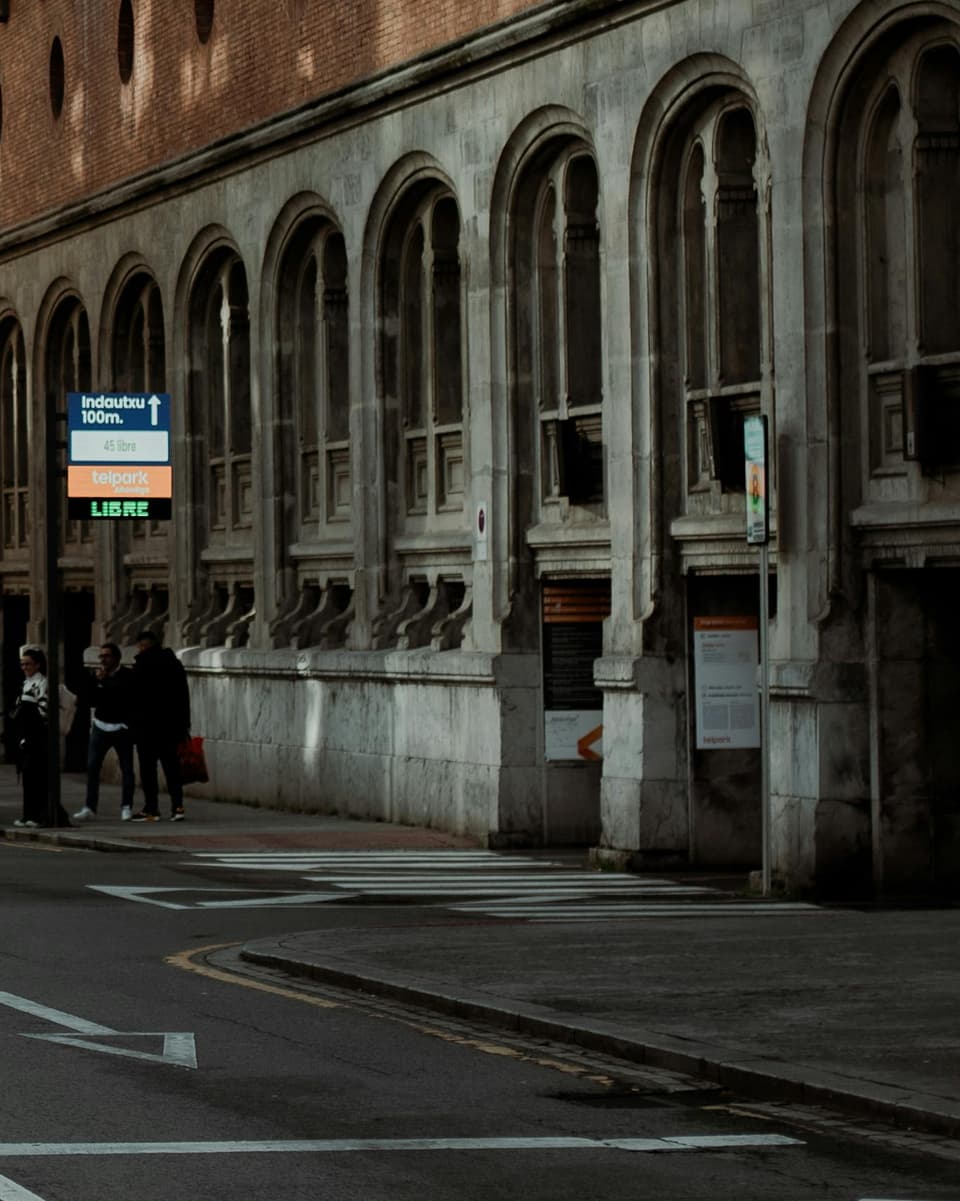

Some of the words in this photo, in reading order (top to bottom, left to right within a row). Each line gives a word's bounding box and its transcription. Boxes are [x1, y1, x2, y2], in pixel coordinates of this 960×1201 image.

[81, 394, 146, 409] Indautxu
[81, 410, 124, 424] 100m.
[103, 440, 115, 452] 45
[91, 470, 149, 487] telpark
[90, 501, 149, 517] LIBRE
